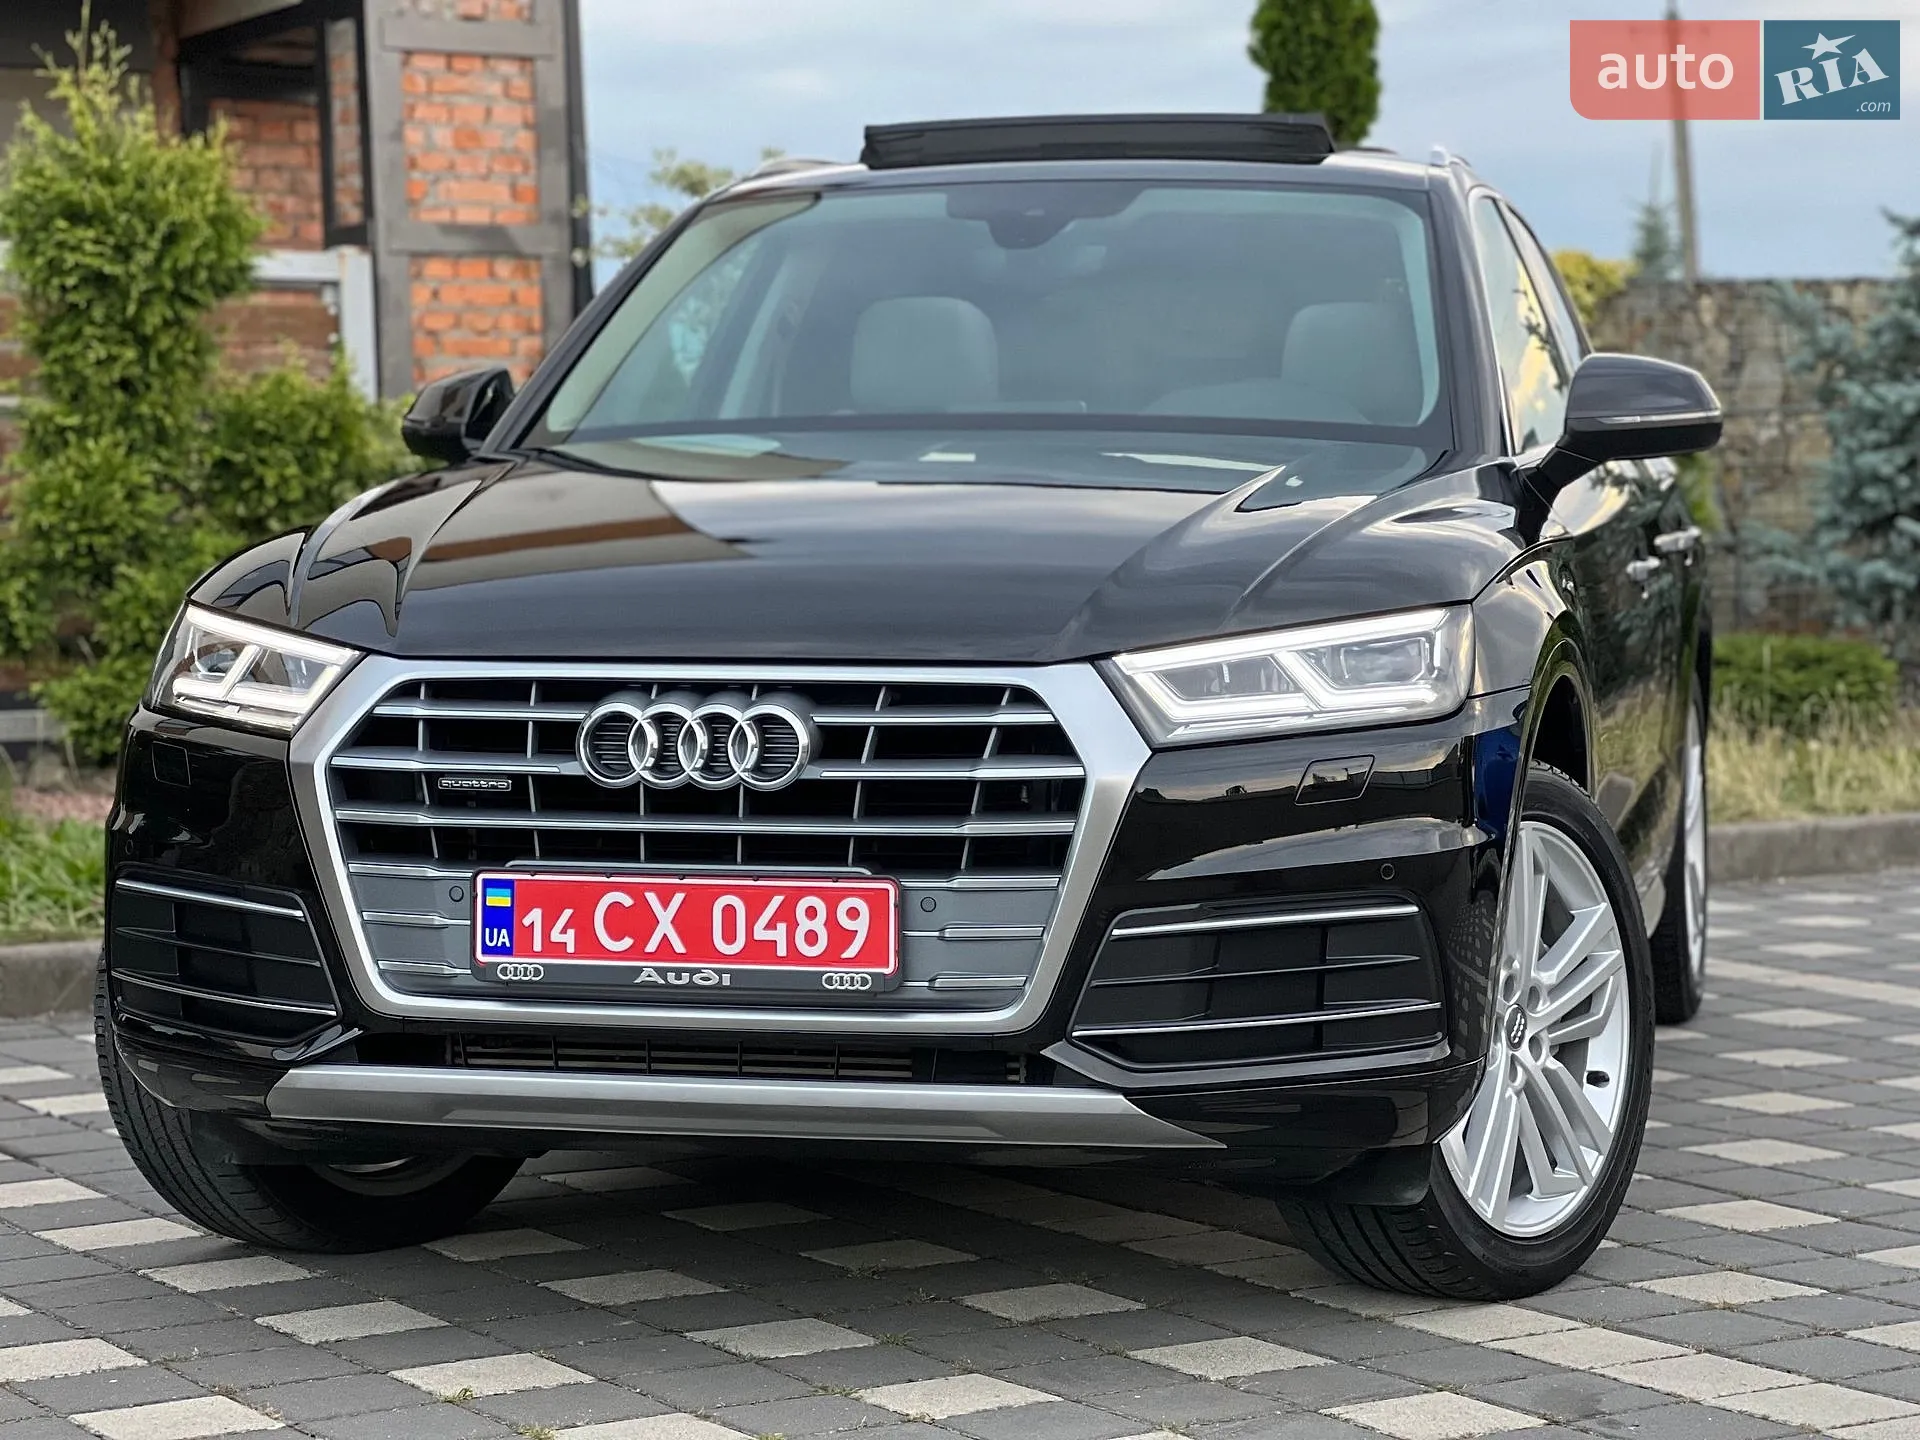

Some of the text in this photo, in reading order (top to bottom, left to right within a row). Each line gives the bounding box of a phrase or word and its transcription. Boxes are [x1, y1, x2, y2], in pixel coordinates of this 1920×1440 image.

[441, 779, 508, 789] quattro
[521, 891, 870, 959] 14 CX 0489
[485, 927, 510, 948] UA
[633, 967, 730, 987] Audi
